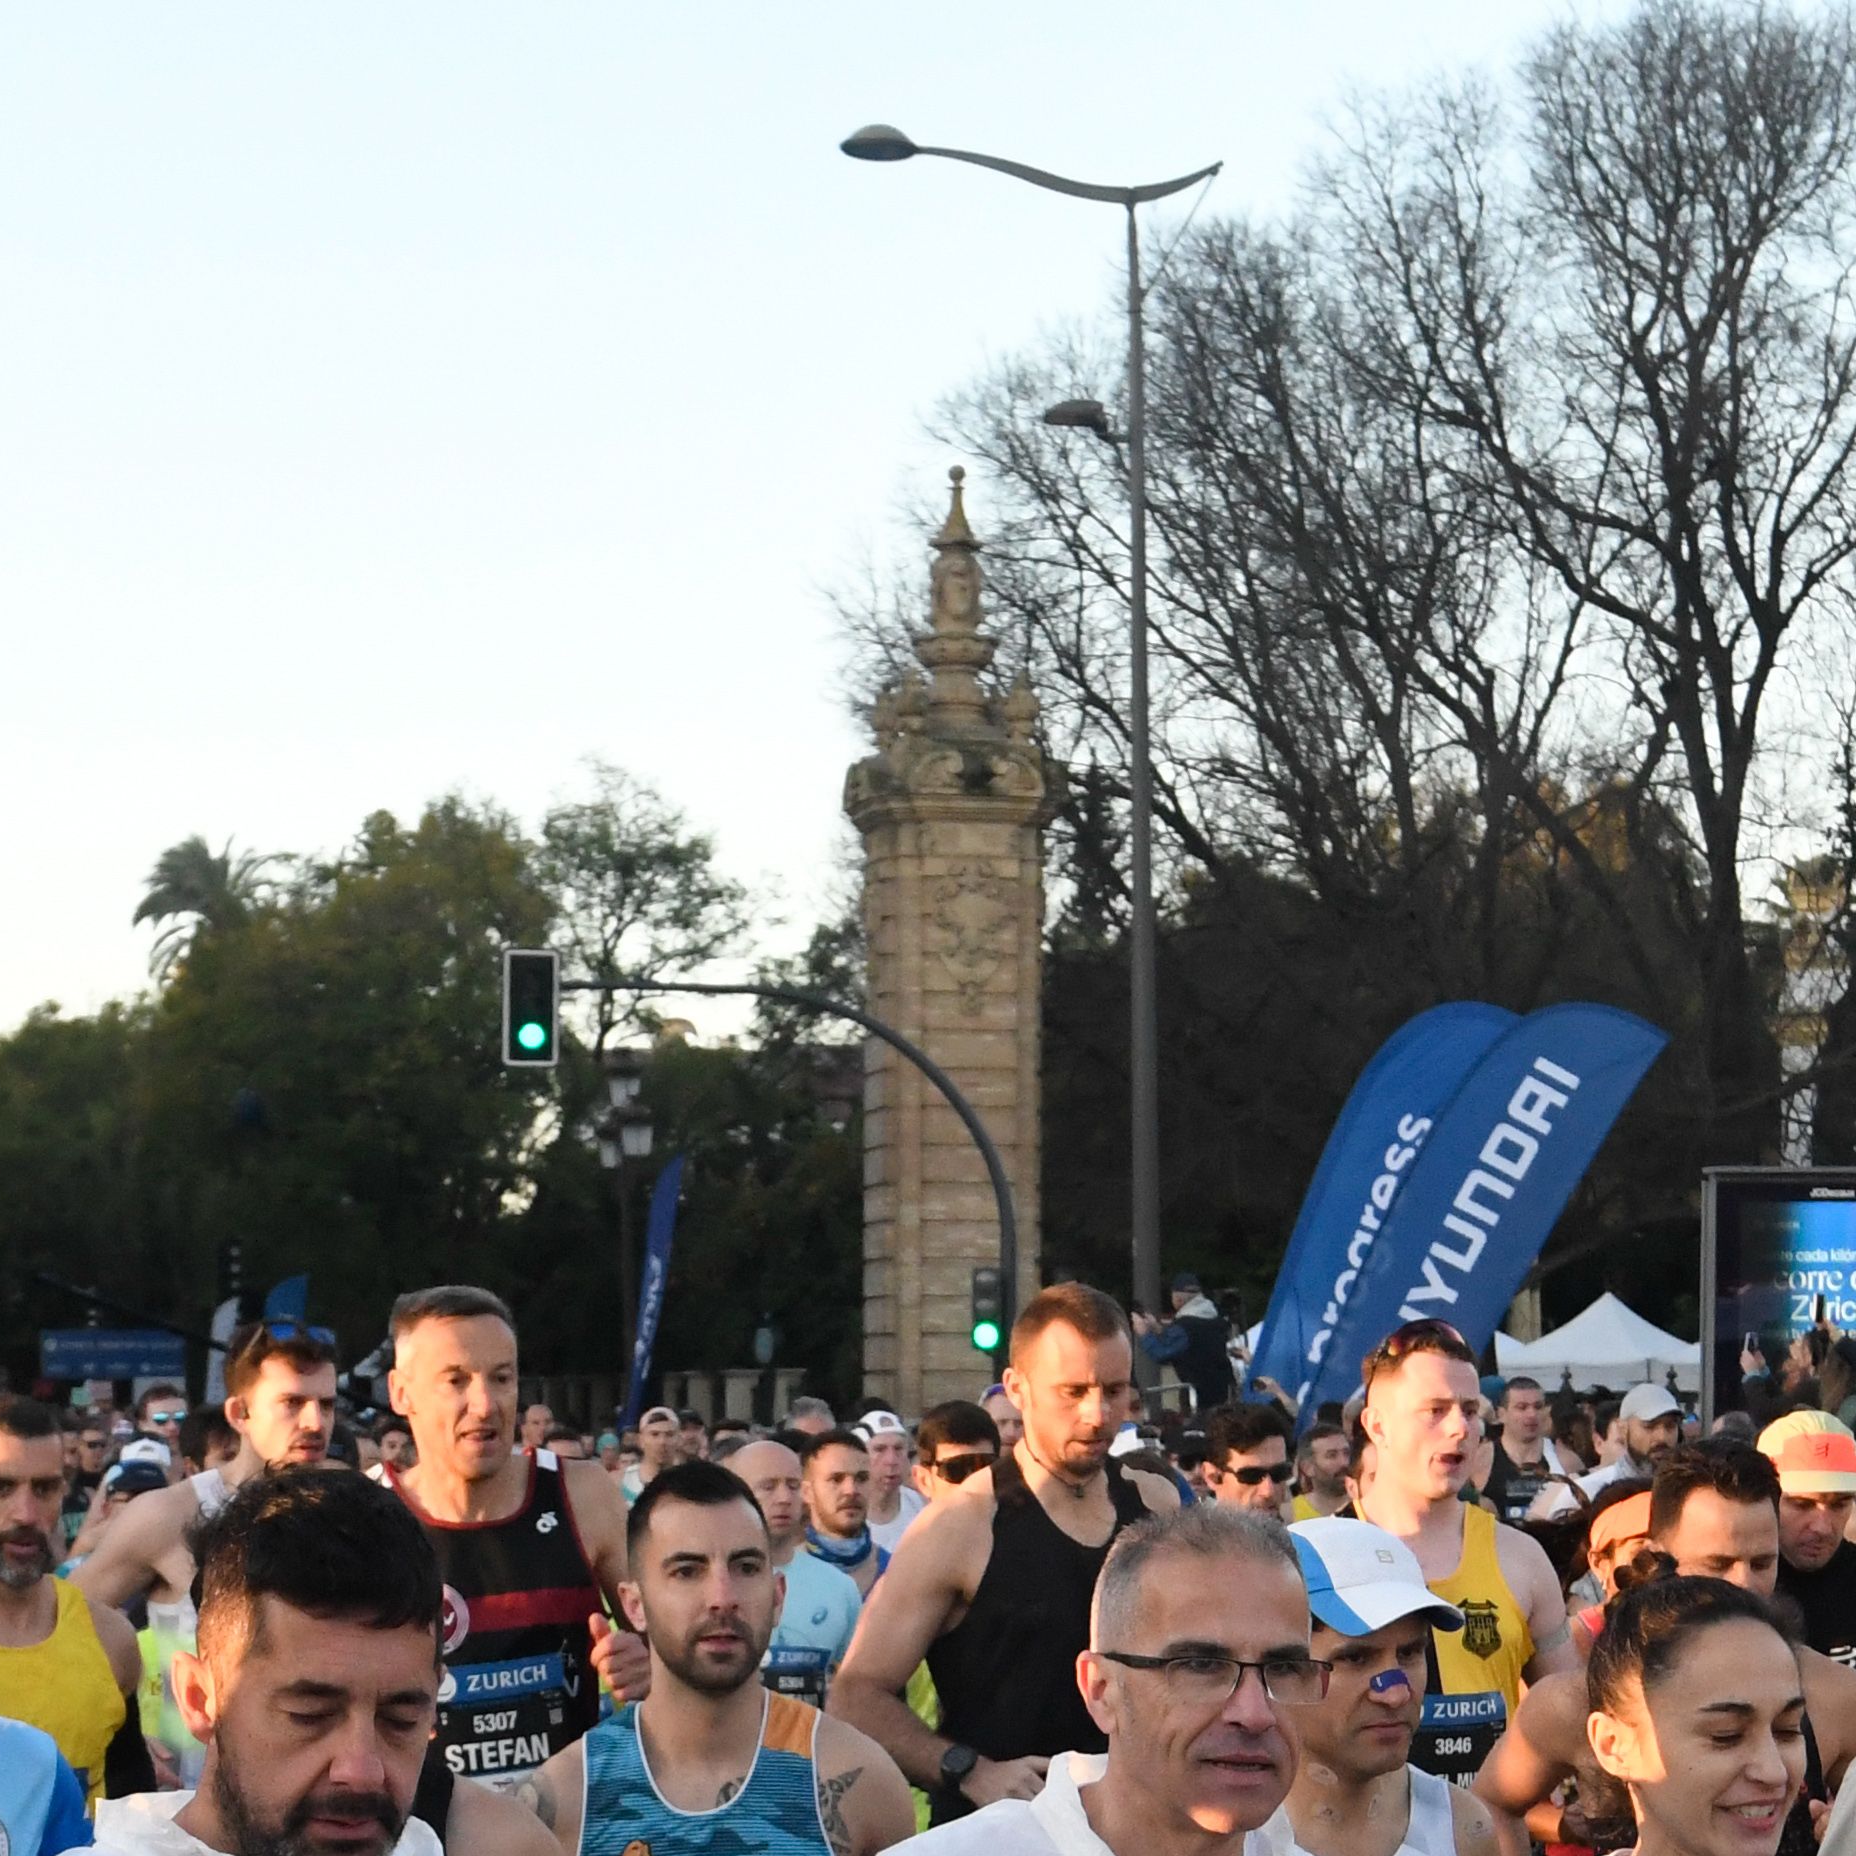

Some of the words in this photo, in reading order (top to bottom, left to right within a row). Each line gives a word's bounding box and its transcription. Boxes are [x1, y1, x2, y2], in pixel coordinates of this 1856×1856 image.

[1399, 1056, 1581, 1322] YUNDAI
[1795, 1249, 1829, 1262] cada
[1773, 1270, 1843, 1291] corre
[466, 1664, 548, 1692] ZURICH
[1432, 1698, 1497, 1719] ZURICH
[473, 1710, 518, 1734] 5307
[445, 1732, 550, 1773] STEFAN
[1434, 1736, 1472, 1755] 3846
